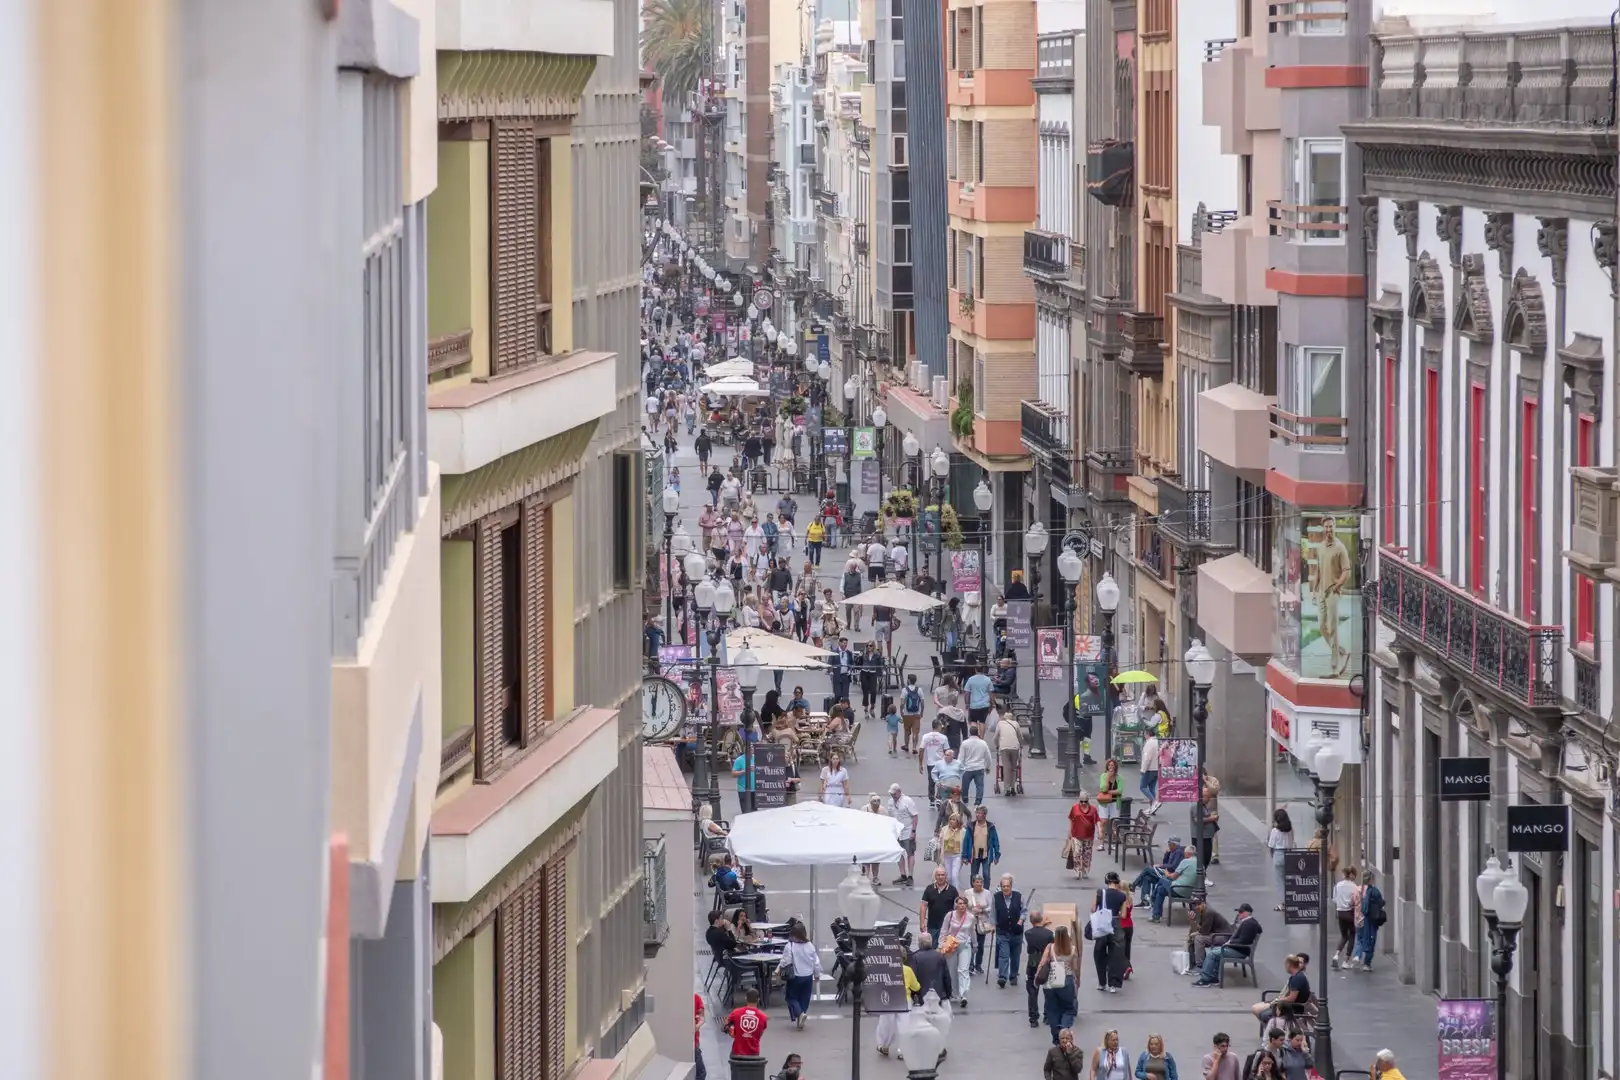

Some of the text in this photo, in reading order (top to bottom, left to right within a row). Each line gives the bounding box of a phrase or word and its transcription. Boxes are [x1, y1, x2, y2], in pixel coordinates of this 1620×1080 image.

[648, 684, 656, 693] 12
[671, 703, 676, 712] 3
[652, 724, 657, 733] 6
[1512, 823, 1564, 834] MANGO
[1443, 1038, 1491, 1056] BRESH
